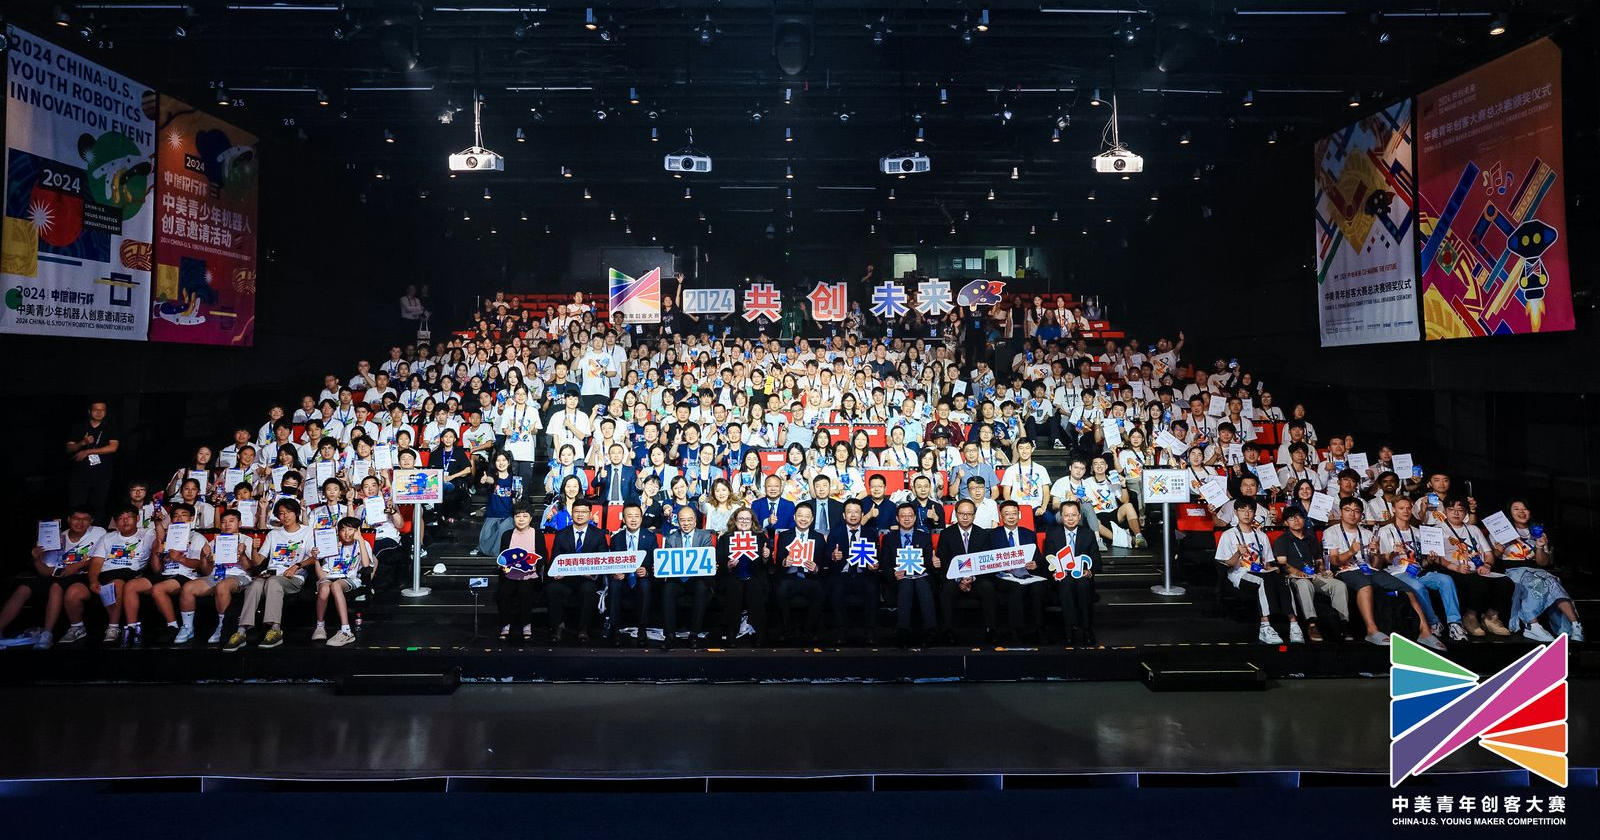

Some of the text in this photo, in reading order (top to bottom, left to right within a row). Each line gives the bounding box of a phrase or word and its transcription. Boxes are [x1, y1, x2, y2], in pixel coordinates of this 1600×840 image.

[9, 33, 134, 100] 2024 CHINA-U.S.
[10, 57, 141, 122] YOUTH ROBOTICS
[10, 81, 152, 146] INNOVATION EVENT
[232, 99, 245, 107] 25
[186, 156, 205, 172] 2024
[42, 168, 81, 194] 2024
[162, 192, 252, 234] 中美青少年机器人
[162, 213, 232, 248] 创意邀请活动
[16, 285, 46, 300] 2024
[685, 290, 733, 312] 2024
[745, 281, 954, 320] 共 创 未 来
[1324, 279, 1412, 301] 中美青年创客大赛总决赛颁奖仪式
[16, 303, 135, 324] 中美青少年机器人创意邀请活动
[557, 555, 637, 566] 中美青年创客大赛总决赛
[656, 549, 713, 576] 2024
[730, 533, 925, 574] 共 创 未 来
[978, 549, 1024, 563] 2024 共创未来
